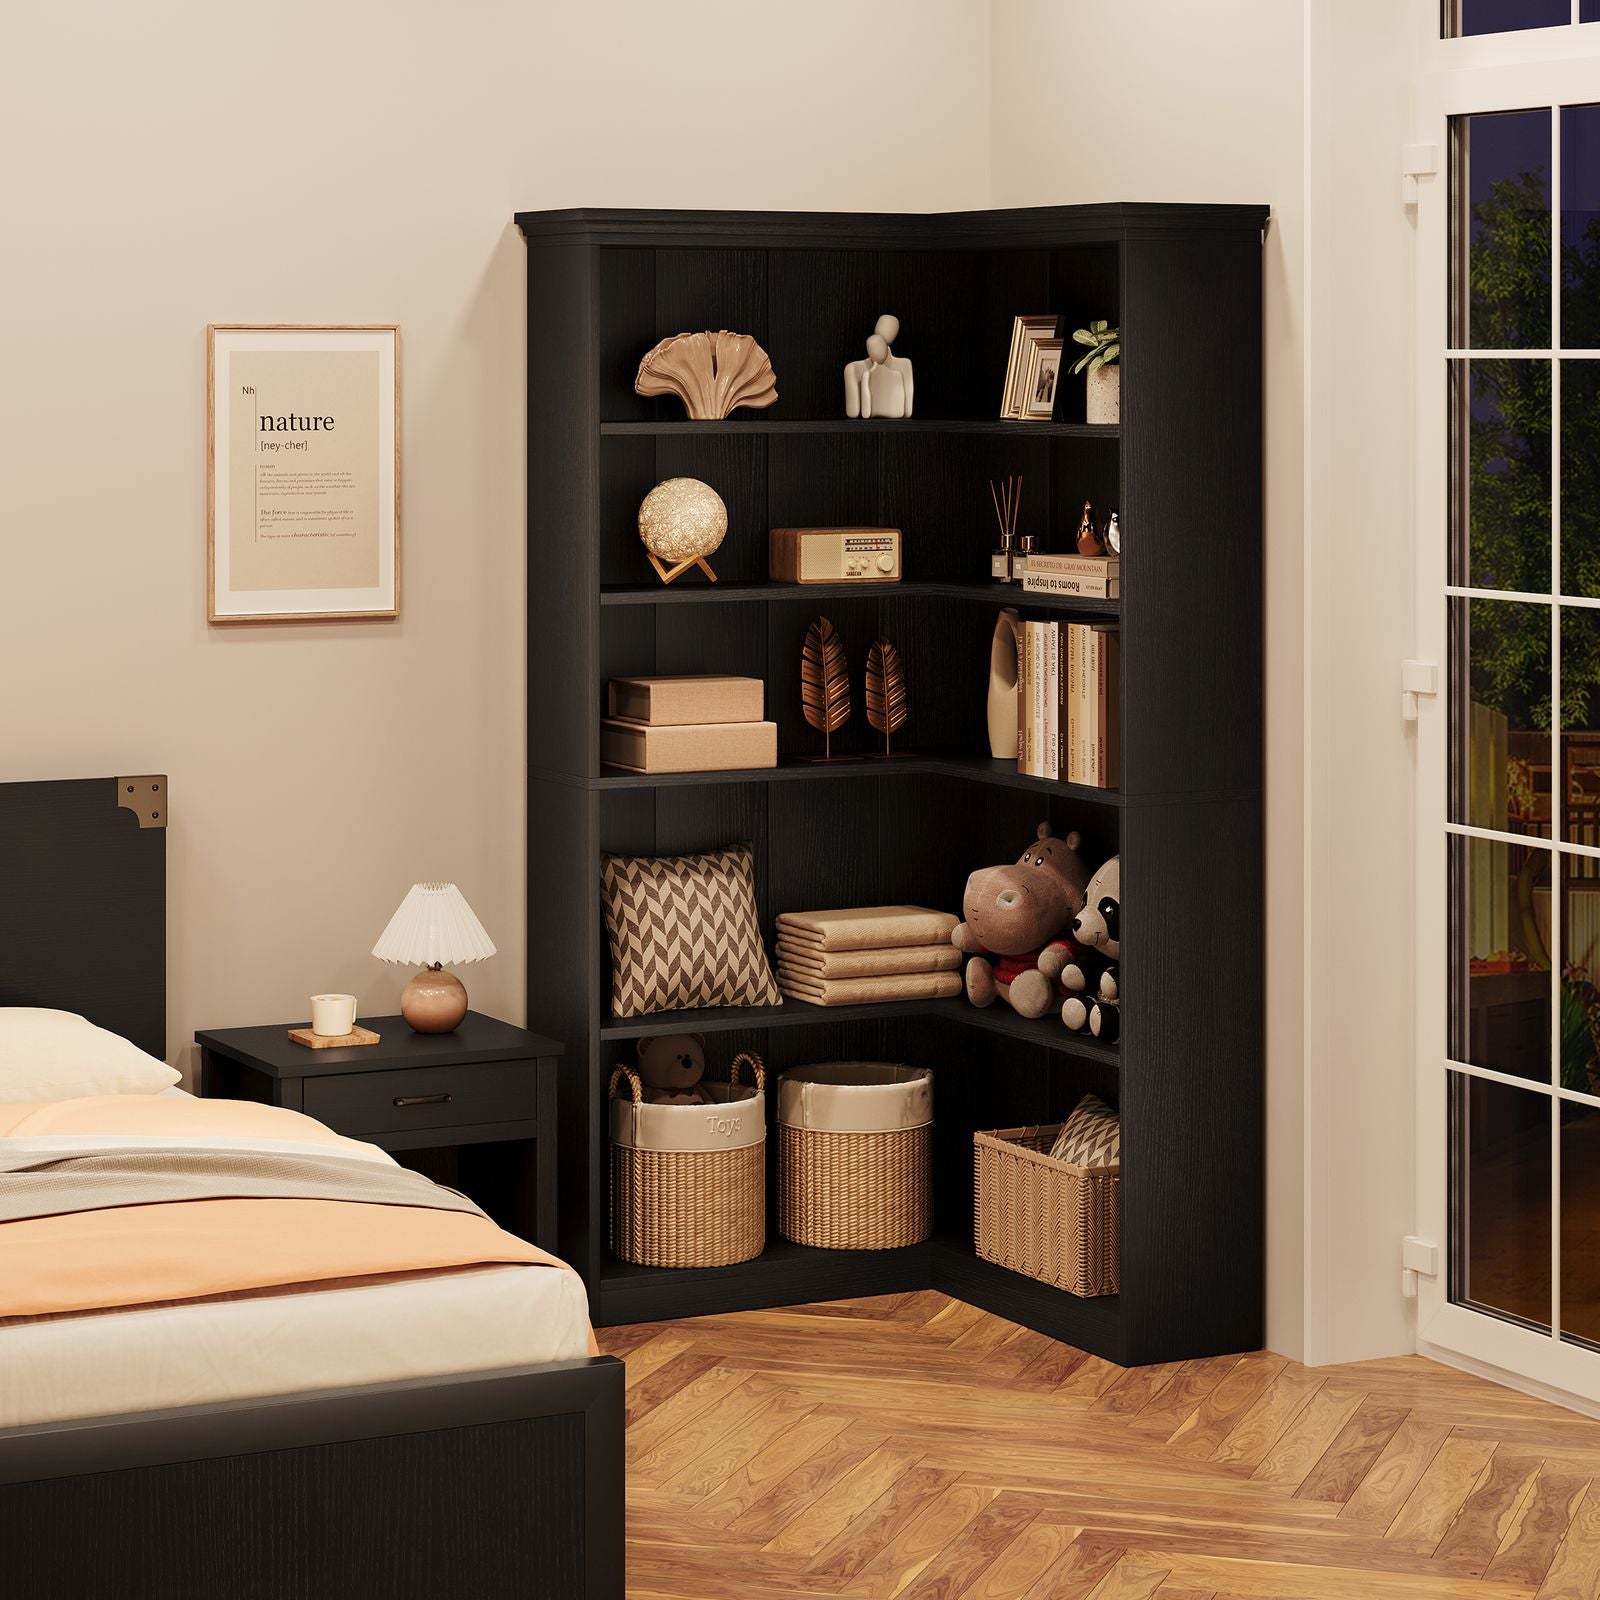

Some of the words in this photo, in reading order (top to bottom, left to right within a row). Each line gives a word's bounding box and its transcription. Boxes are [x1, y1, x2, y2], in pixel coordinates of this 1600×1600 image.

[242, 386, 255, 395] Nh
[260, 413, 335, 432] nature
[260, 440, 308, 452] [ney-cher]
[1027, 577, 1049, 589] Inspire
[1050, 580, 1057, 588] to
[1058, 580, 1080, 592] Rooms
[706, 1116, 743, 1137] Toys
